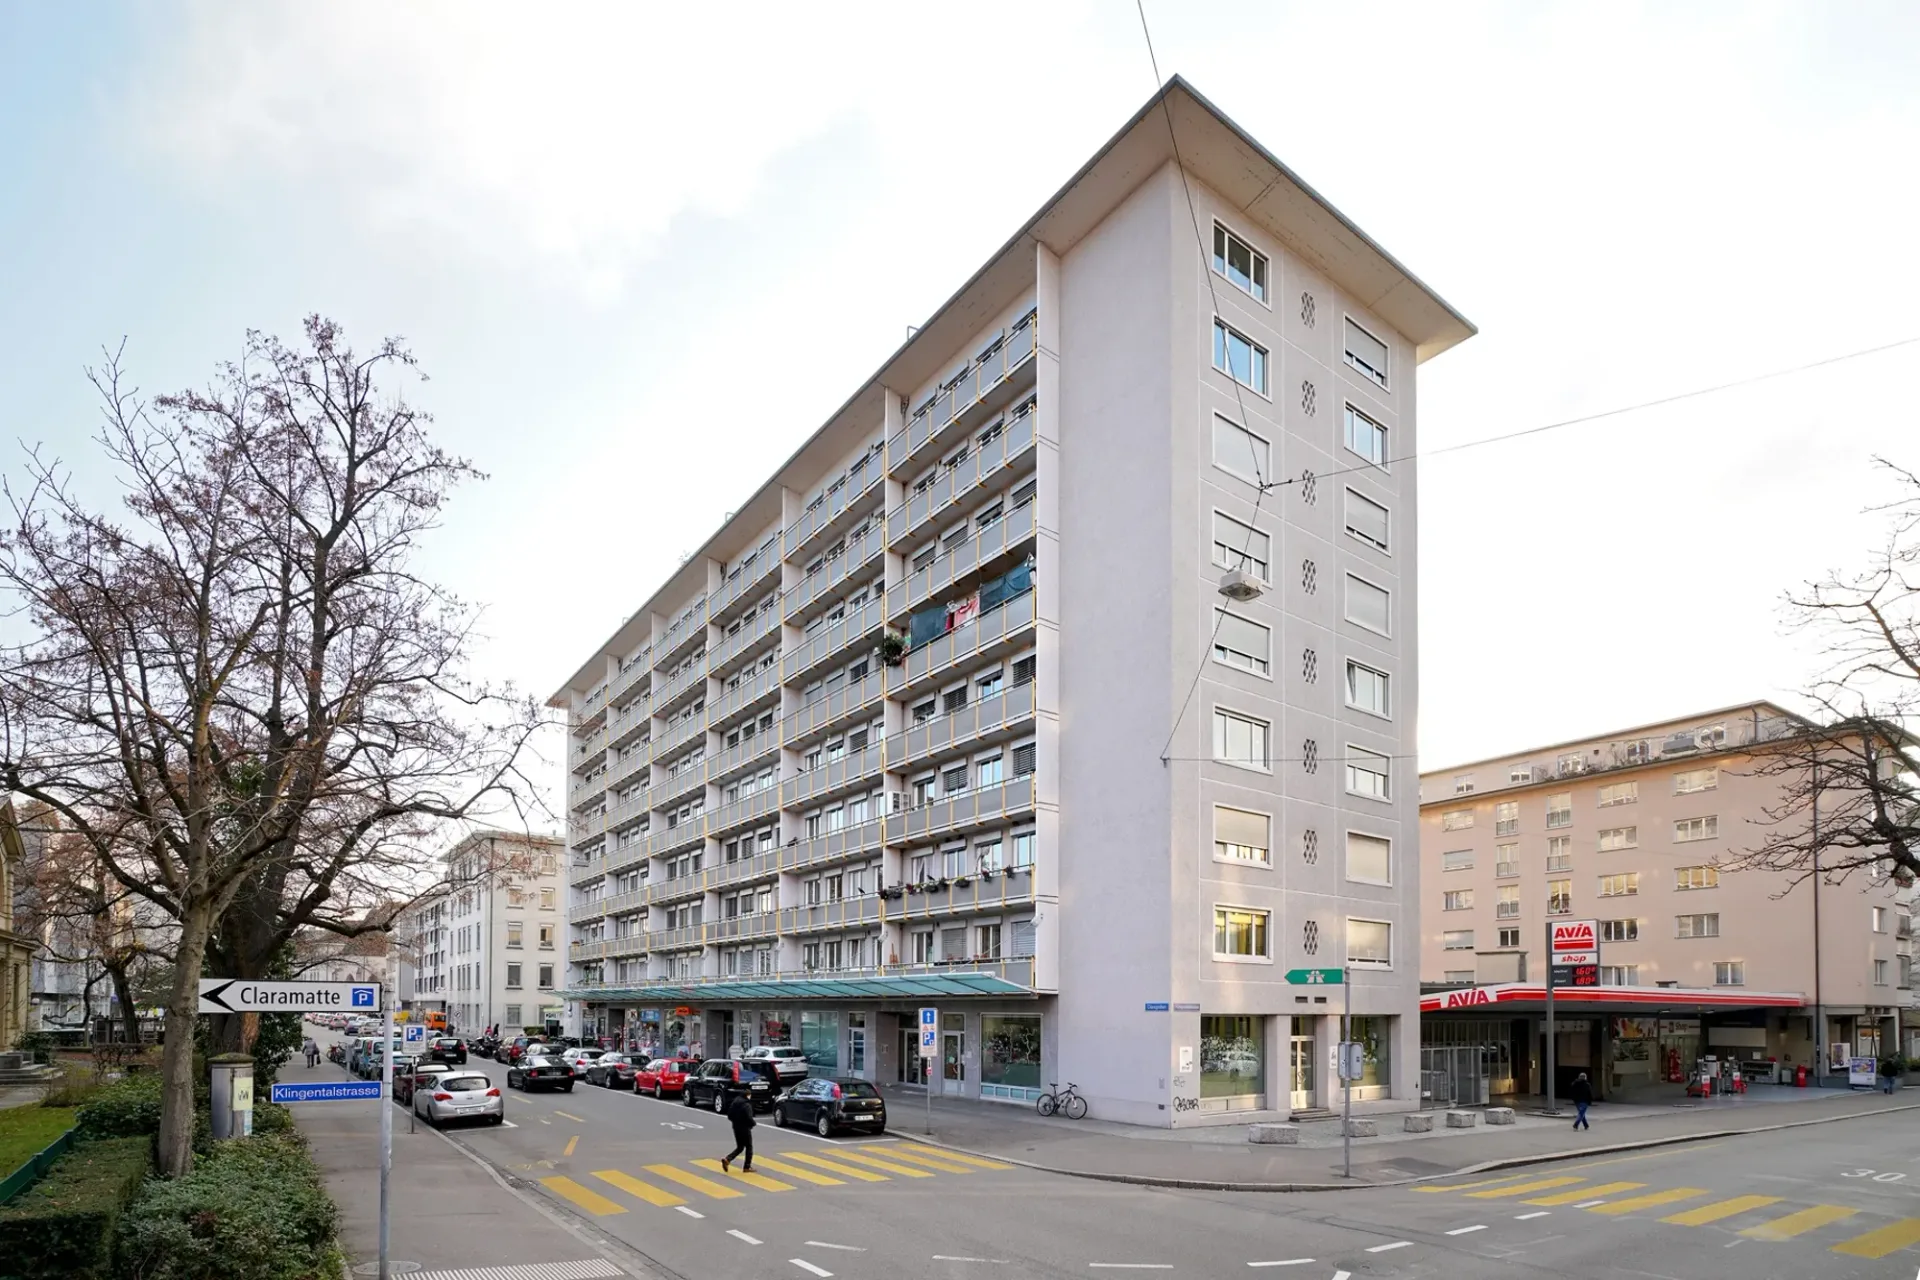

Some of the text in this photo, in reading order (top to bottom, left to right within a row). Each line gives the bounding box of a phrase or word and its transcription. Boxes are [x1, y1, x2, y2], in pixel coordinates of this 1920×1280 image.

[1555, 923, 1593, 938] AVIA
[1562, 955, 1587, 963] shop
[240, 986, 368, 1005] Claramatte P
[1448, 986, 1489, 1007] AVIA
[408, 1028, 417, 1040] P
[275, 1086, 379, 1100] Klingentalstrasse
[660, 1121, 704, 1130] 30
[1840, 1168, 1908, 1182] 30
